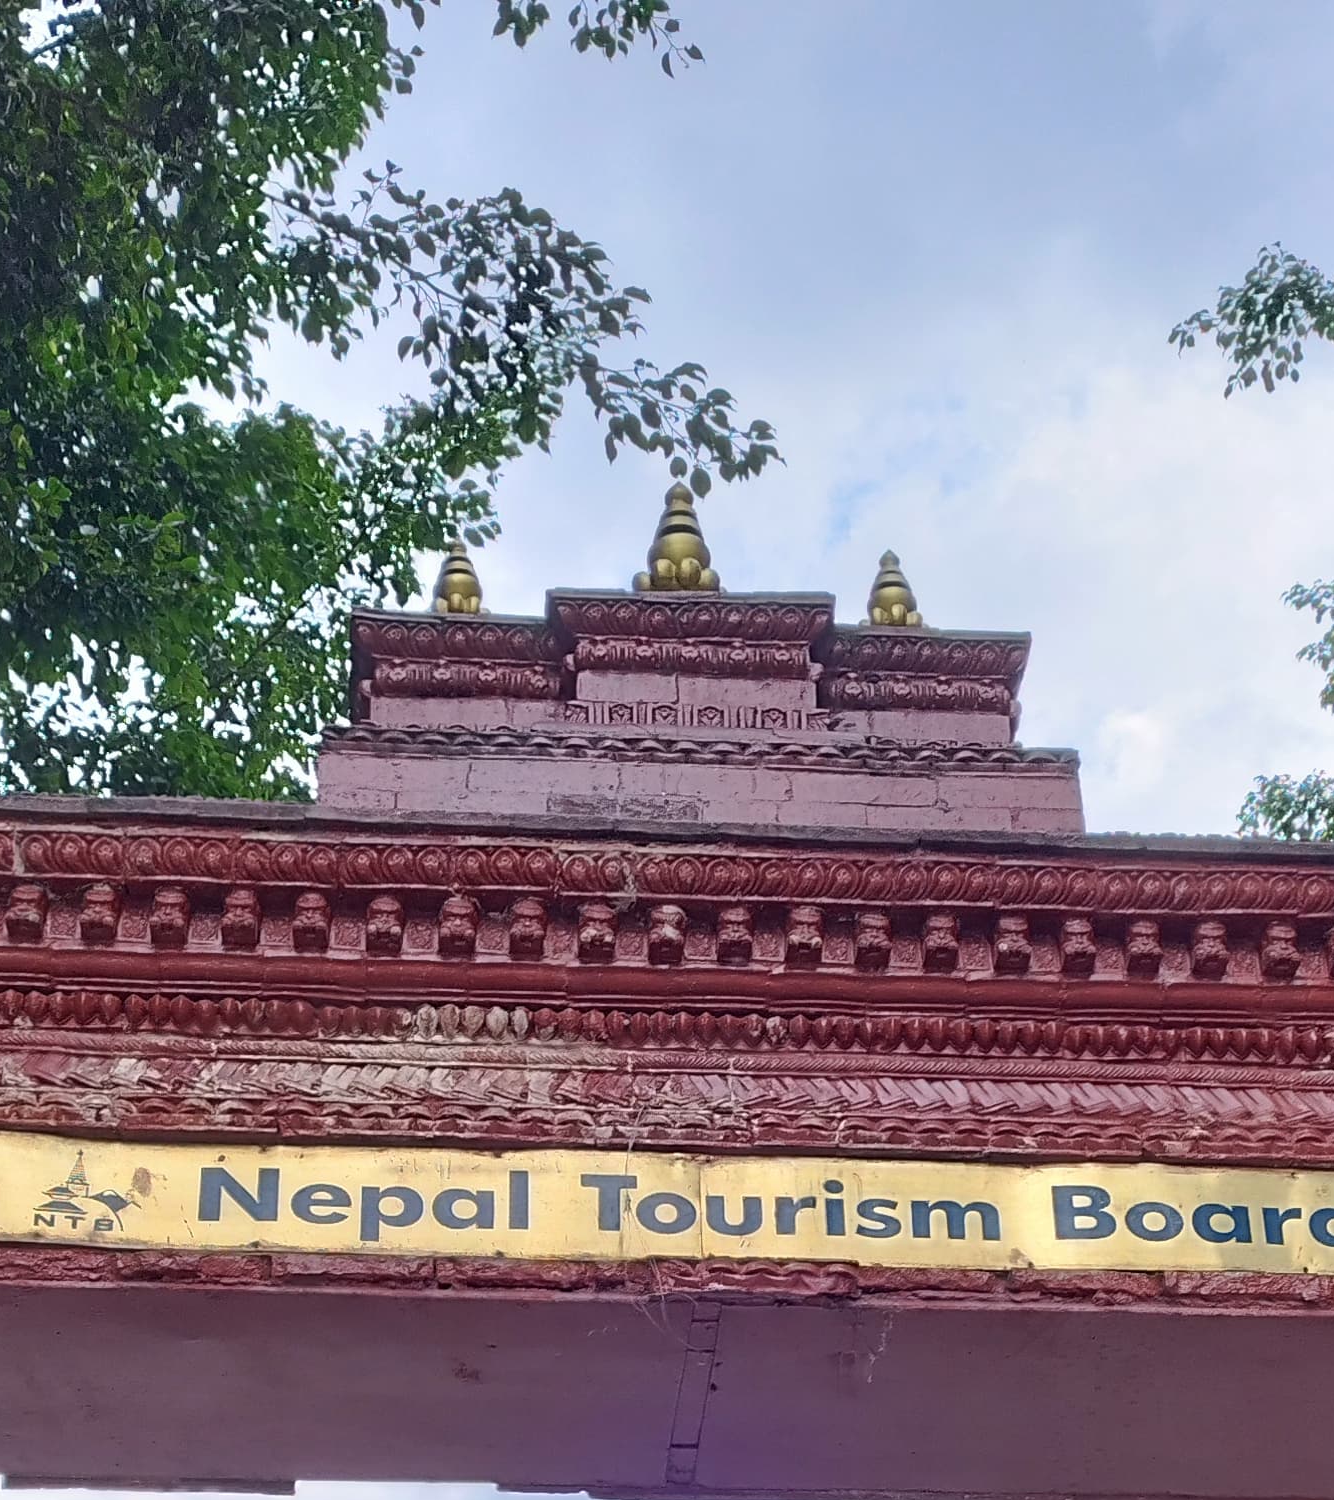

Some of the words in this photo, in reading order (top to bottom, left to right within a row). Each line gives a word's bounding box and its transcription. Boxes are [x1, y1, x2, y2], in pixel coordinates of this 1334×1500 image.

[33, 1213, 114, 1232] NTB
[198, 1167, 529, 1242] Nepal
[580, 1173, 1002, 1241] Tourism
